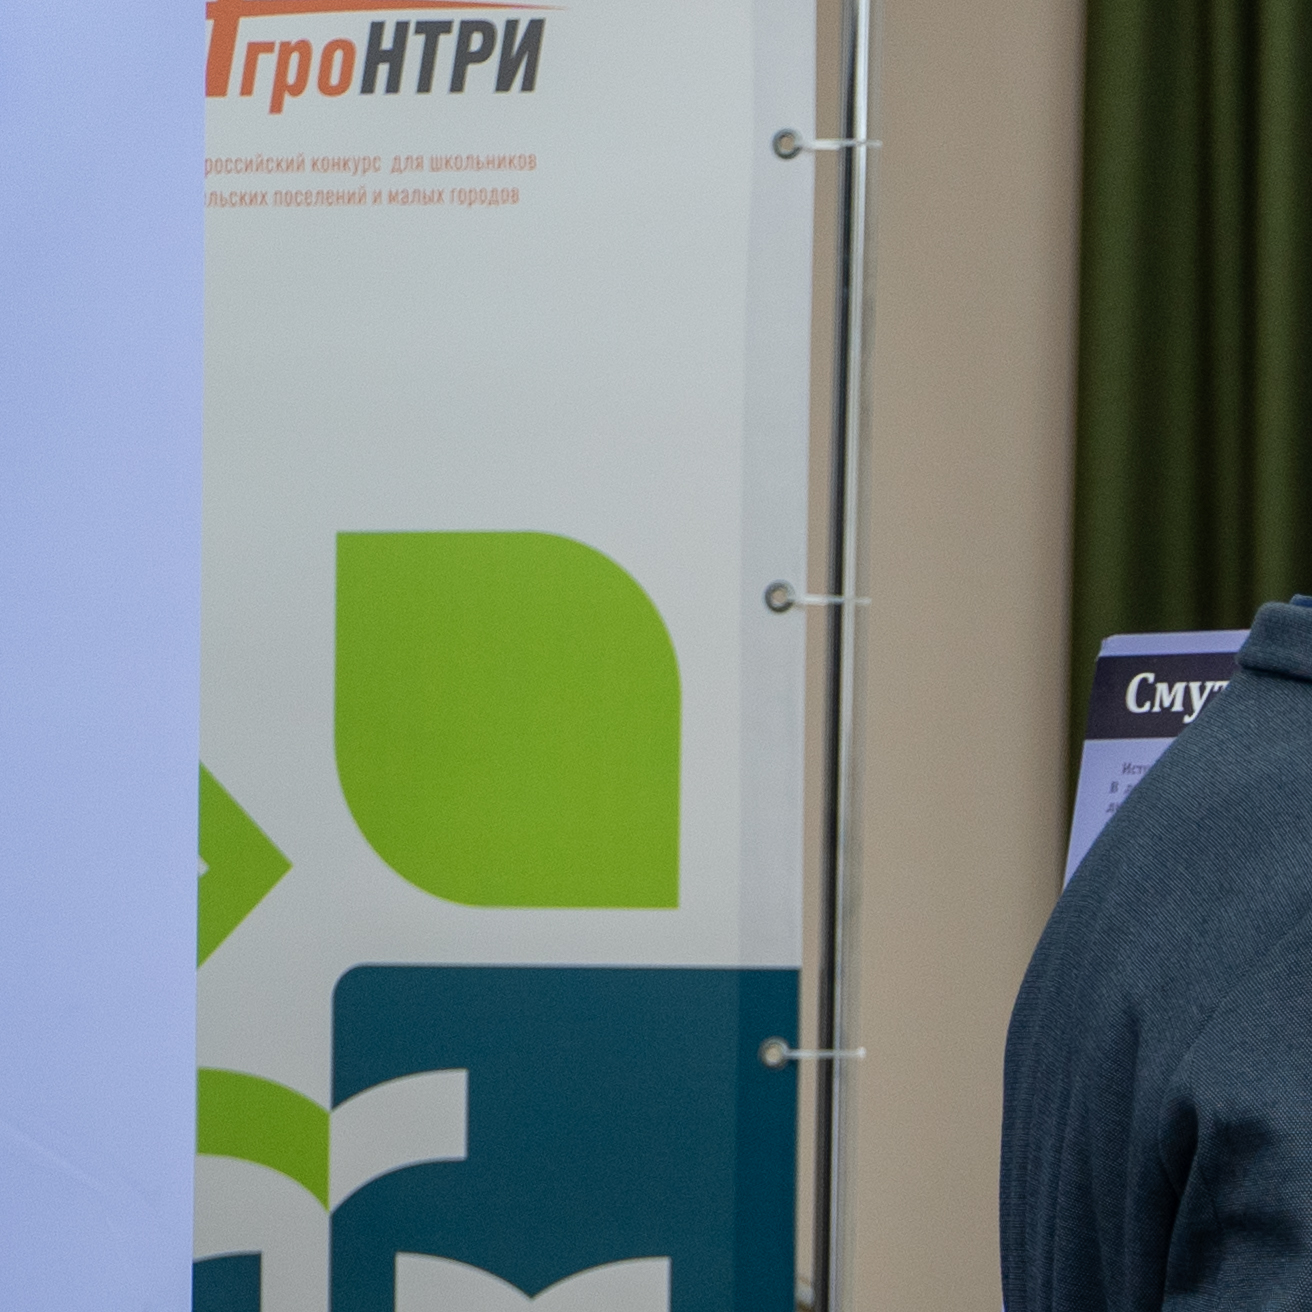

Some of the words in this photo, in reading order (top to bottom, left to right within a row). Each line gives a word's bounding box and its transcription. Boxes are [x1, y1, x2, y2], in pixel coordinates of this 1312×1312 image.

[310, 154, 382, 177] конкурс
[389, 153, 424, 176] для
[428, 152, 537, 173] школьников
[204, 188, 268, 208] льских
[273, 184, 367, 208] поселений
[371, 188, 383, 206] и
[387, 187, 445, 207] малых
[450, 187, 520, 209] городов
